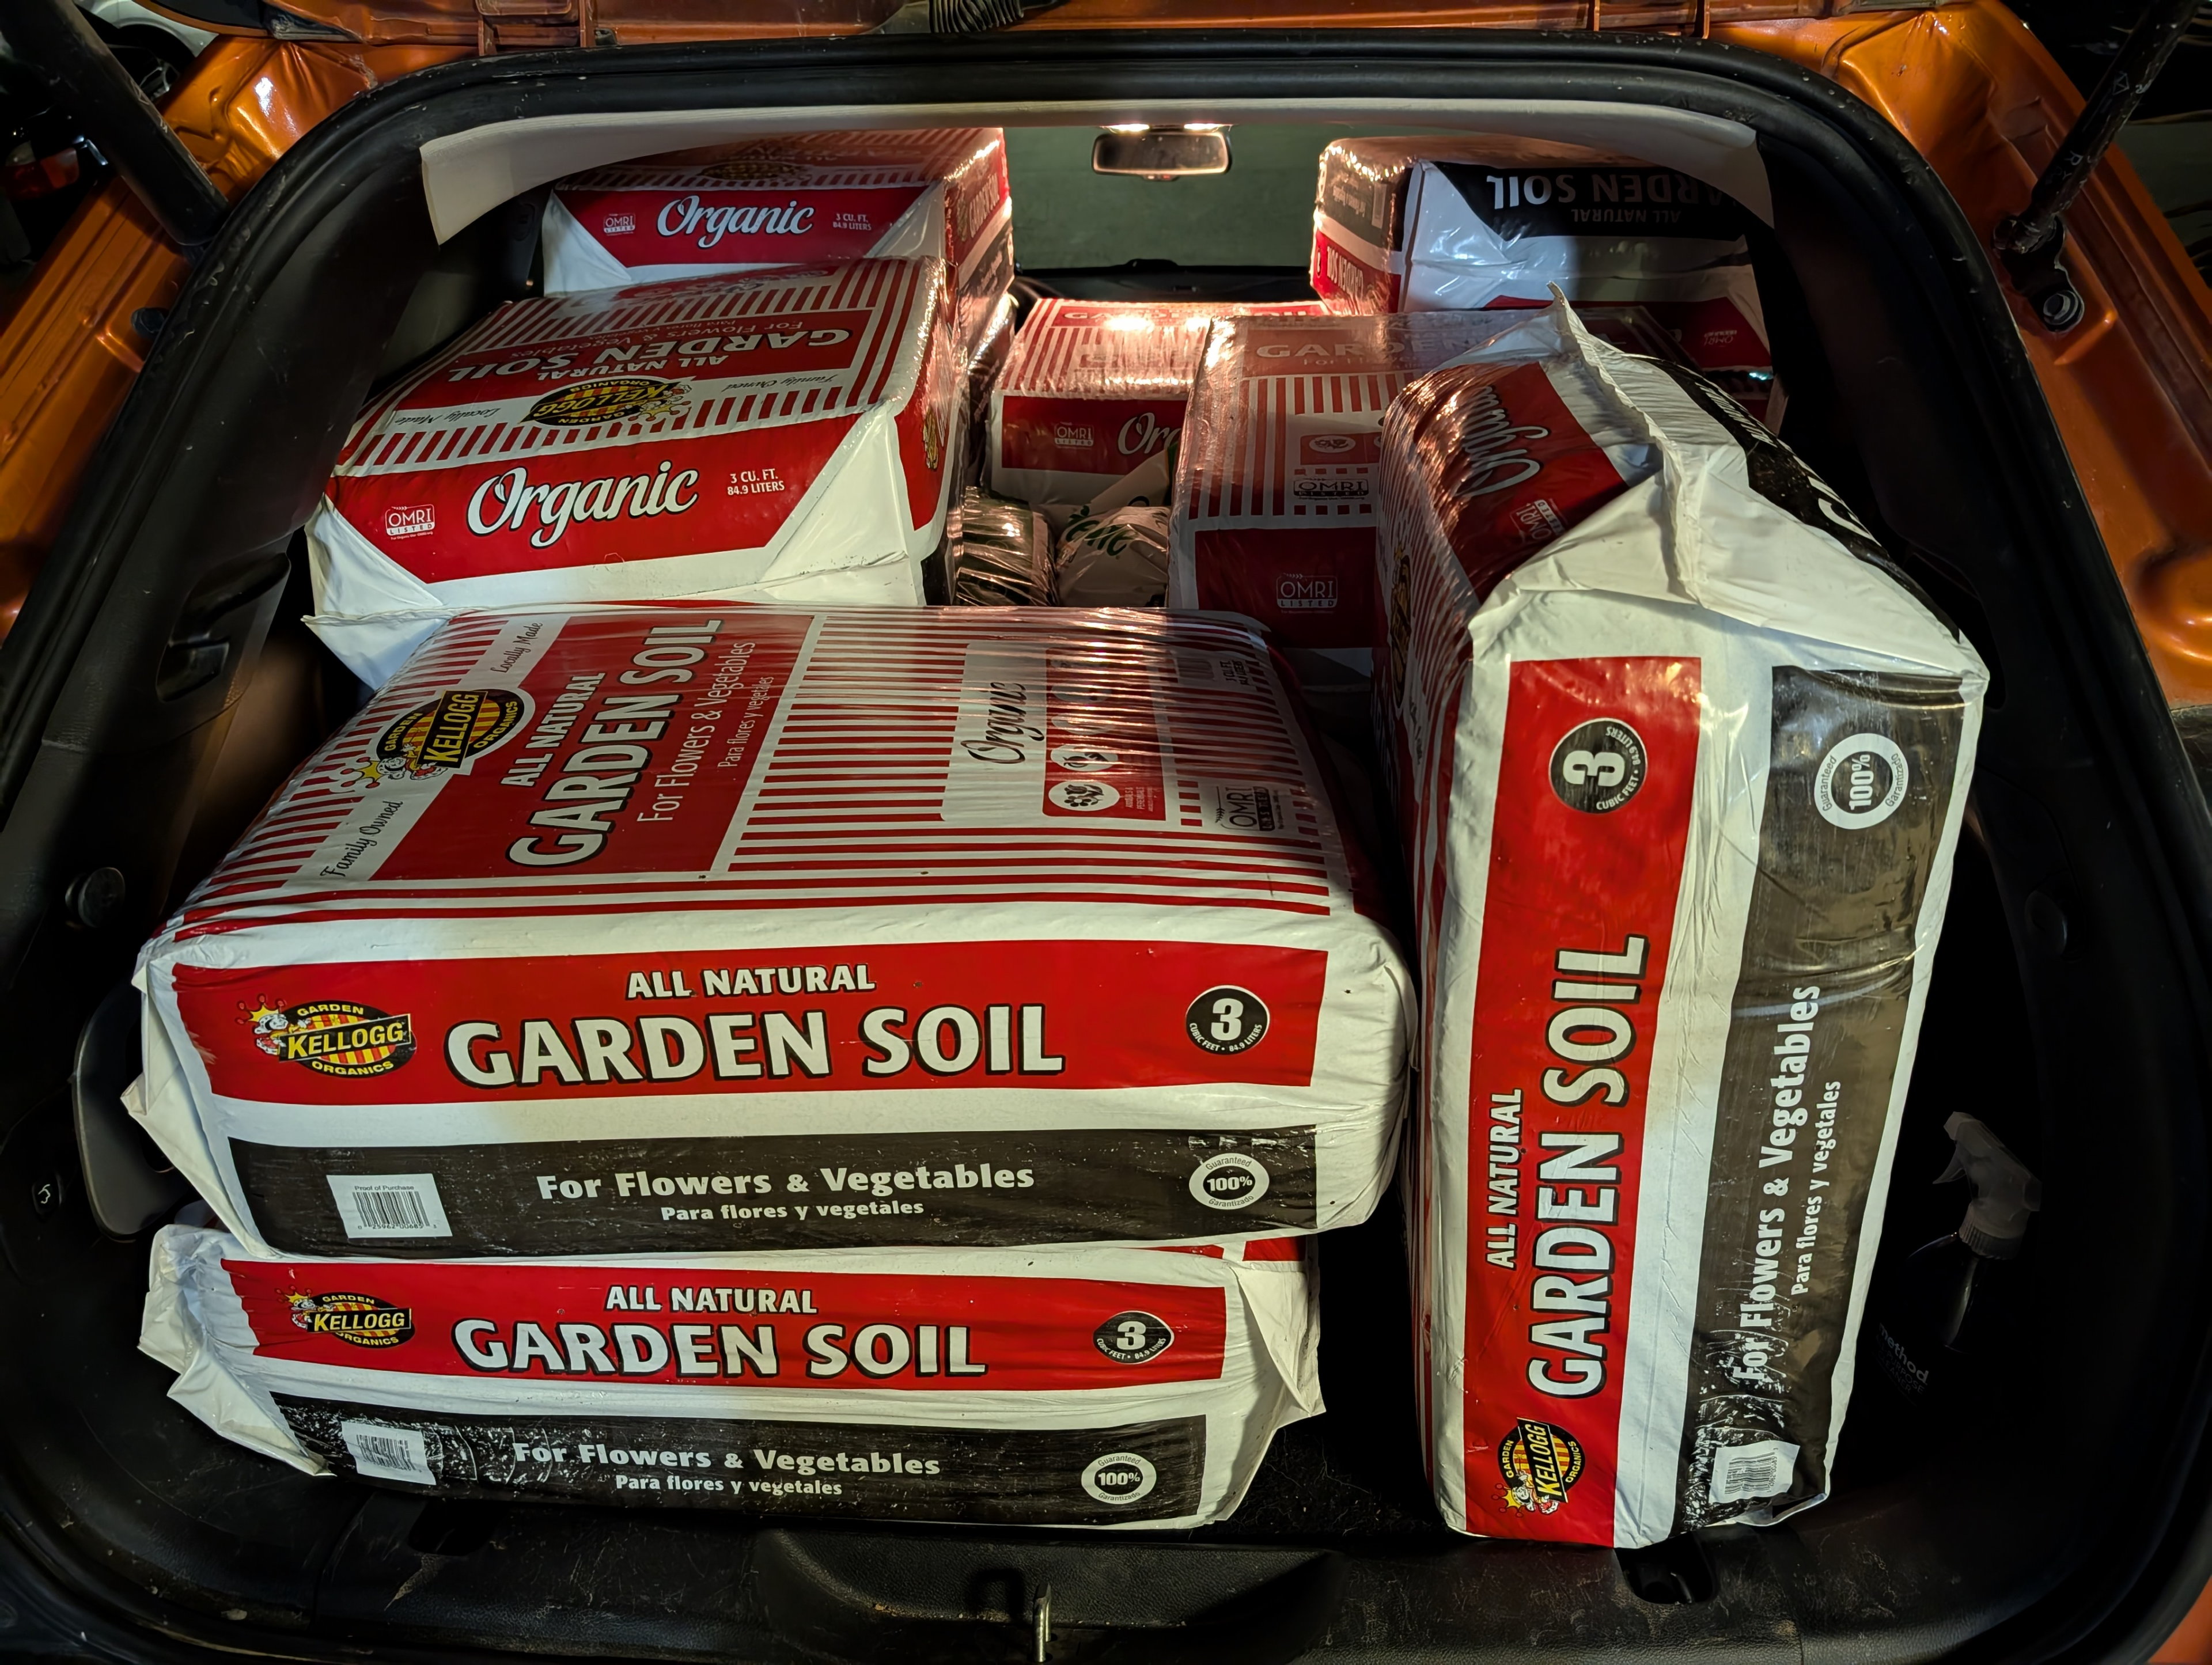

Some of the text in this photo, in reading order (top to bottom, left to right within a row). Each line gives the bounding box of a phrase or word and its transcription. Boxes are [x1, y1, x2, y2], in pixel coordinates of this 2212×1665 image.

[1486, 173, 1735, 210] ARDEN SOIL
[604, 215, 634, 227] OMRI
[656, 195, 815, 249] Organic
[1571, 208, 1681, 223] ALL NATURAL
[666, 324, 755, 339] Flowers
[764, 321, 804, 330] For
[448, 329, 851, 382] GARDEN SOIL
[512, 336, 631, 358] Vegetables
[537, 355, 729, 381] ALL NATURAL
[569, 380, 650, 393] ORGANICS
[533, 381, 682, 418] KELLOGG
[1056, 426, 1092, 439] OMRI
[727, 481, 785, 496] 84.9 LITERS
[729, 468, 779, 484] 3 CU. FT.
[1298, 481, 1365, 490] OMRI
[388, 508, 431, 527] OMRI
[467, 460, 700, 549] Organic
[1516, 505, 1552, 540] OMRI
[389, 524, 433, 534] LISTED
[1281, 581, 1334, 598] OMRI
[490, 623, 543, 673] Locally Made
[384, 712, 424, 752] GARDEN
[422, 693, 480, 763] KELLOGG
[473, 700, 518, 749] ORGANICS
[500, 672, 606, 787] ALL NATURAL
[637, 642, 756, 822] For Flowers & Vegetables
[717, 676, 774, 768] Para flores y vegetales
[960, 681, 1044, 765] Organic
[505, 619, 725, 868] GARDEN SOIL
[1563, 750, 1625, 787] 3
[1596, 726, 1641, 810] CUBIC FEET 84.9 LITERS
[1820, 754, 1837, 811] Guaranteed
[1849, 754, 1874, 810] 100%
[1885, 753, 1904, 807] Garantizado
[1225, 787, 1257, 827] OMRI
[320, 800, 403, 878] Family Owned
[626, 963, 876, 1000] ALL NATURAL
[297, 1004, 364, 1017] GARDEN
[1210, 998, 1244, 1041] 3
[287, 1022, 406, 1061] KELLOGG
[444, 1003, 1065, 1089] GARDEN SOIL
[1189, 1022, 1263, 1052] CUBIC FEET 84.9 LITERS
[311, 1060, 395, 1077] ORGANICS
[536, 1163, 1035, 1200] For Flowers & Vegetables
[1205, 1156, 1252, 1170] Guaranteed
[1486, 1087, 1524, 1269] ALL NATURAL
[1525, 933, 1650, 1399] GARDEN SOIL
[1206, 1175, 1253, 1192] 100%
[1208, 1195, 1254, 1207] Garantizado
[1732, 985, 1821, 1380] For Flowers & Vegetables
[1791, 1080, 1841, 1296] Para flores y vegetales
[661, 1200, 925, 1220] Para flores y vegetales
[322, 1294, 374, 1305] GARDEN
[606, 1285, 819, 1315] ALL NATURAL
[313, 1312, 406, 1333] KELLOGG
[335, 1331, 399, 1347] ORGANICS
[1116, 1321, 1146, 1351] 3
[452, 1317, 988, 1379] GARDEN SOIL
[1108, 1349, 1126, 1360] FEET
[1134, 1349, 1150, 1360] 84.9
[1149, 1337, 1166, 1352] LITERS
[512, 1442, 941, 1476] For Flowers & Vegetables
[1097, 1455, 1141, 1467] Guaranteed
[1502, 1439, 1514, 1478] GARDEN
[1525, 1424, 1563, 1496] KELLOGG
[1565, 1440, 1582, 1483] ORGANICS
[615, 1474, 843, 1496] Para flores y vegetales
[1098, 1471, 1141, 1486] 100%
[1098, 1492, 1141, 1501] Garantizado
